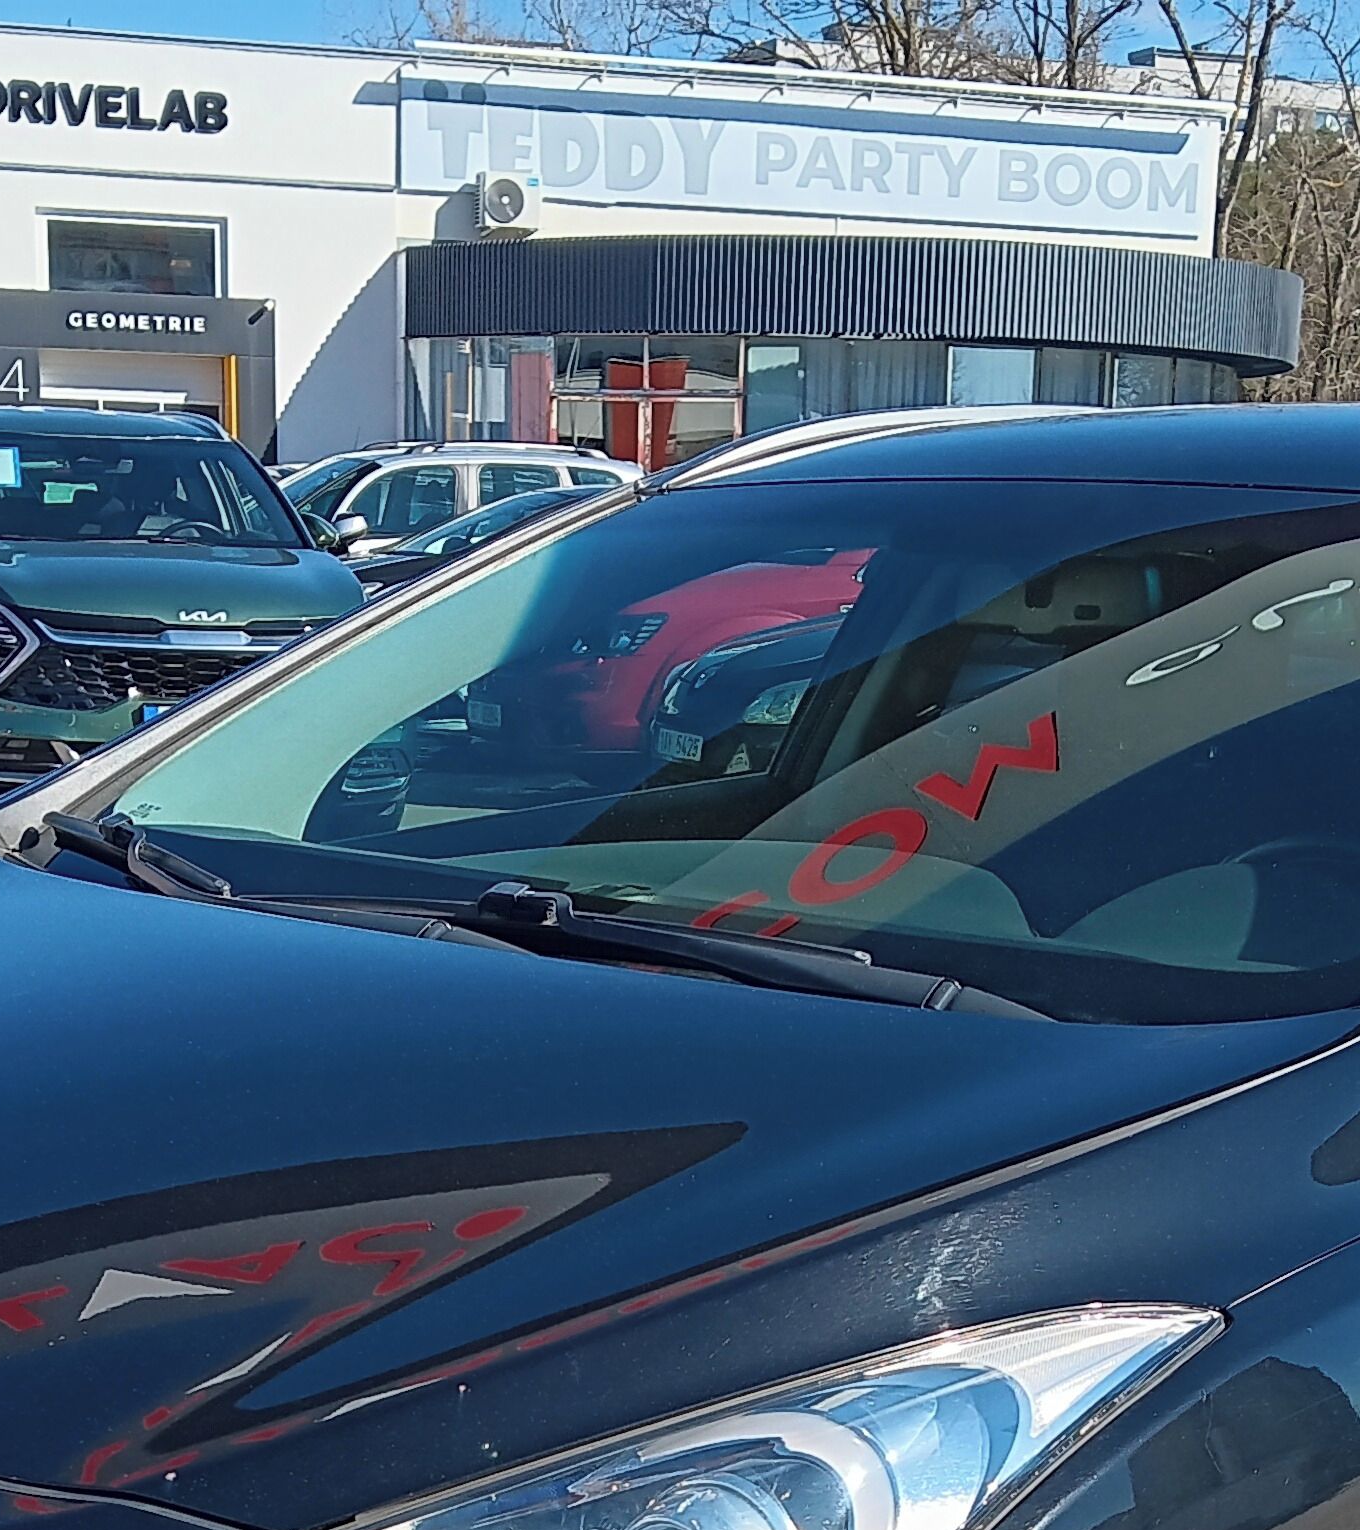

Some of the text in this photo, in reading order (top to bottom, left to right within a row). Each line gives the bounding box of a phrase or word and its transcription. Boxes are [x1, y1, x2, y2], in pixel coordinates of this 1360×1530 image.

[423, 79, 1199, 214] TEDDY PARTY BOOM
[66, 311, 207, 334] GEOMETRIE
